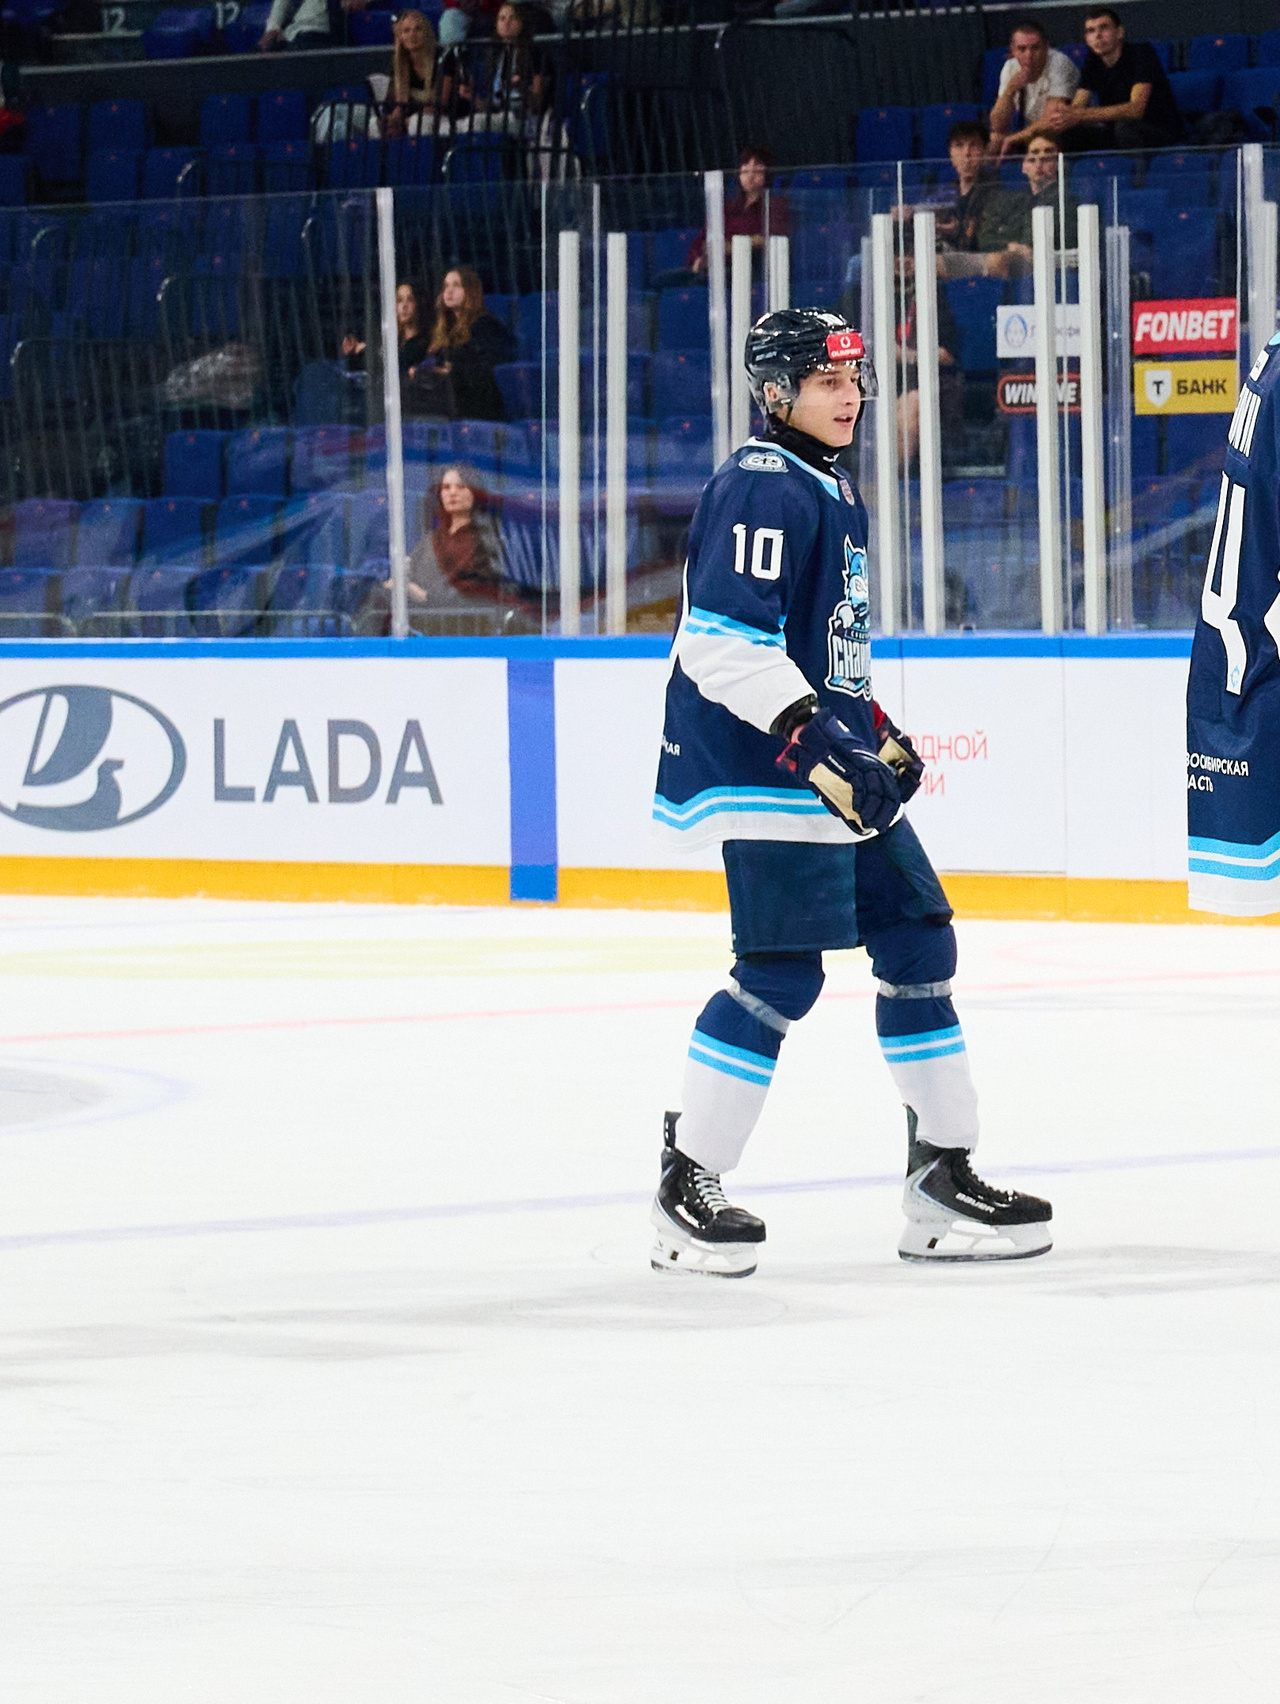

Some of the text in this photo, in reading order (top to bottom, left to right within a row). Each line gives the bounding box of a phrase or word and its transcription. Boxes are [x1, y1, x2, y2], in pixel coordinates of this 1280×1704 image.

[1135, 309, 1235, 342] FONBET
[1177, 379, 1227, 395] БАНК
[733, 523, 784, 581] 10
[213, 718, 444, 805] LADA
